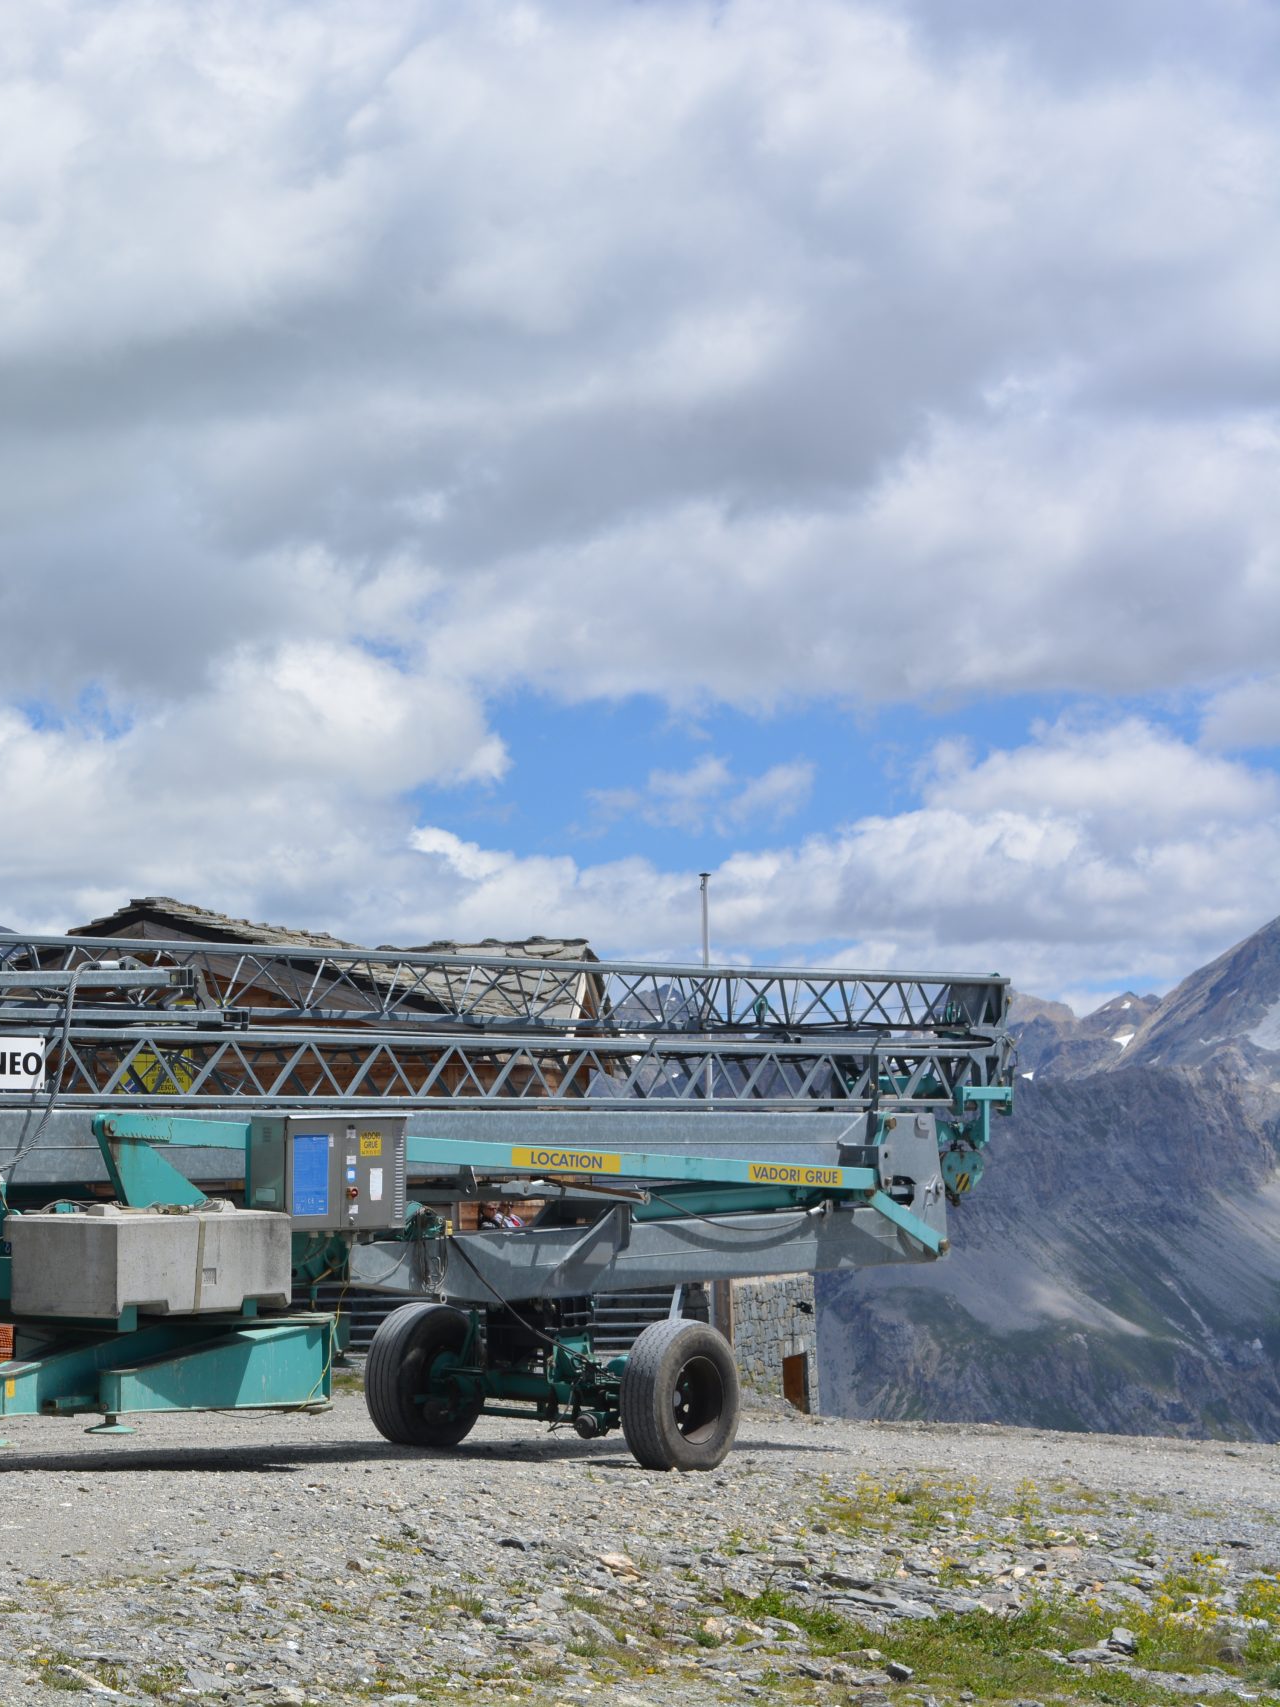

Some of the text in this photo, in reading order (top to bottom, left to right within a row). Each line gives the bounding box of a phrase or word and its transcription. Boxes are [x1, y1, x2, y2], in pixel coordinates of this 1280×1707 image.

[530, 1151, 603, 1169] LOCATION
[752, 1165, 838, 1184] VADORI GRUE
